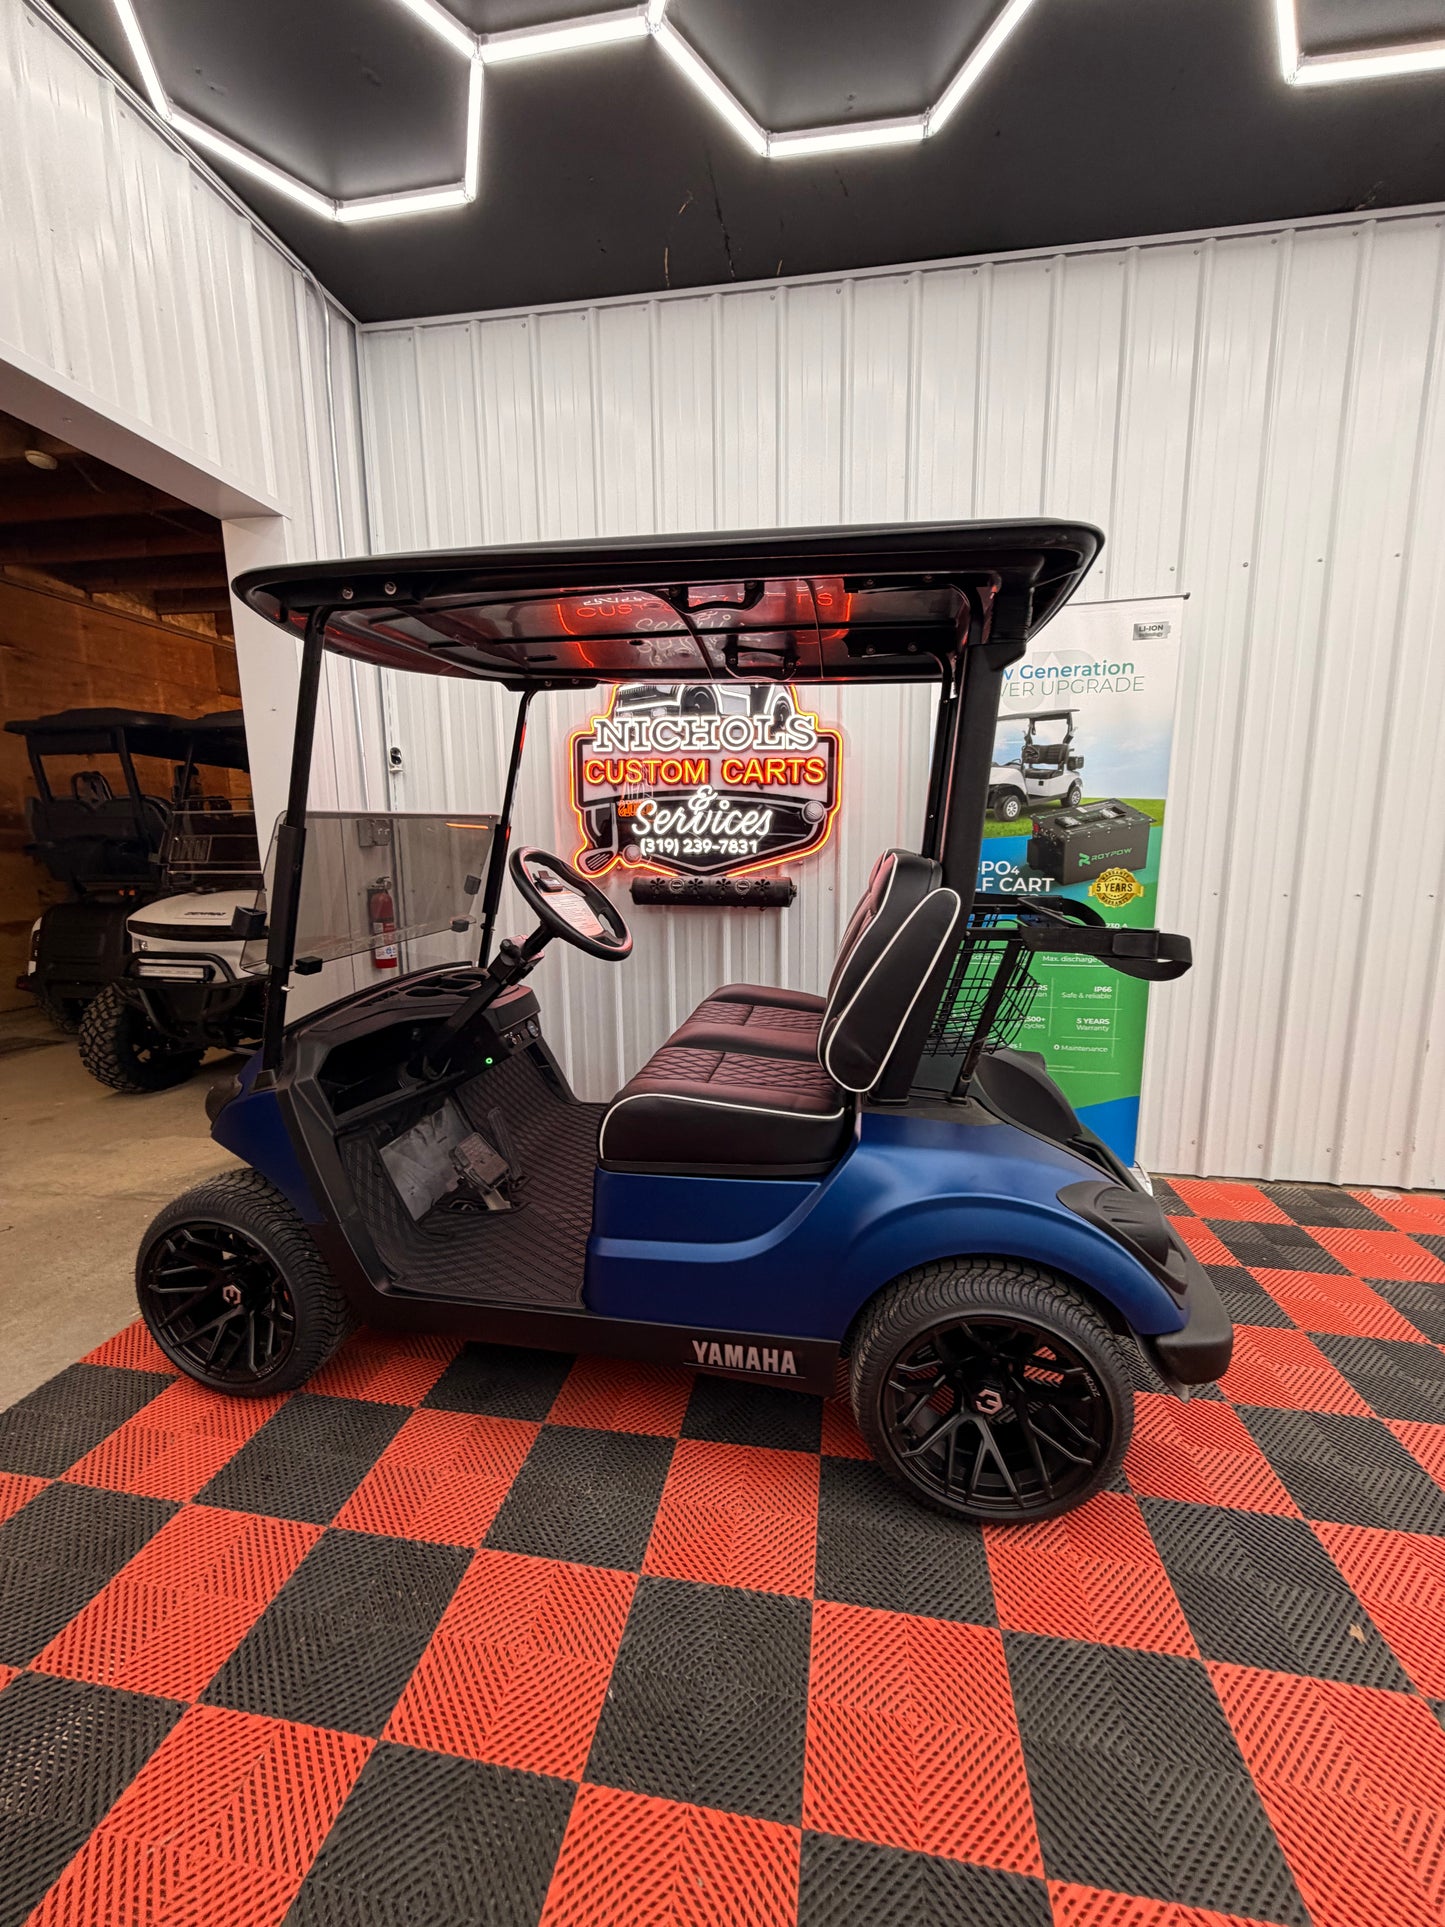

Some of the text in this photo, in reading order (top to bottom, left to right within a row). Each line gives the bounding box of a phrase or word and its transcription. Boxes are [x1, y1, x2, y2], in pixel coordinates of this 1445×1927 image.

[1020, 660, 1134, 679] Generation
[1041, 676, 1145, 696] UPGRADE
[592, 715, 817, 752] NICHOLS
[585, 757, 827, 785] CUSTOM CARTS
[688, 784, 718, 811] &
[631, 799, 774, 835] Services
[640, 838, 758, 856] (319) 239-7831
[1091, 848, 1132, 861] ROYPOW
[999, 877, 1055, 892] CART
[1096, 883, 1133, 892] 5 YEARS
[1061, 991, 1077, 999] Safe
[1076, 1024, 1109, 1032] Warranty
[1061, 1045, 1109, 1053] Maintenance
[692, 1340, 797, 1375] YAMAHA
